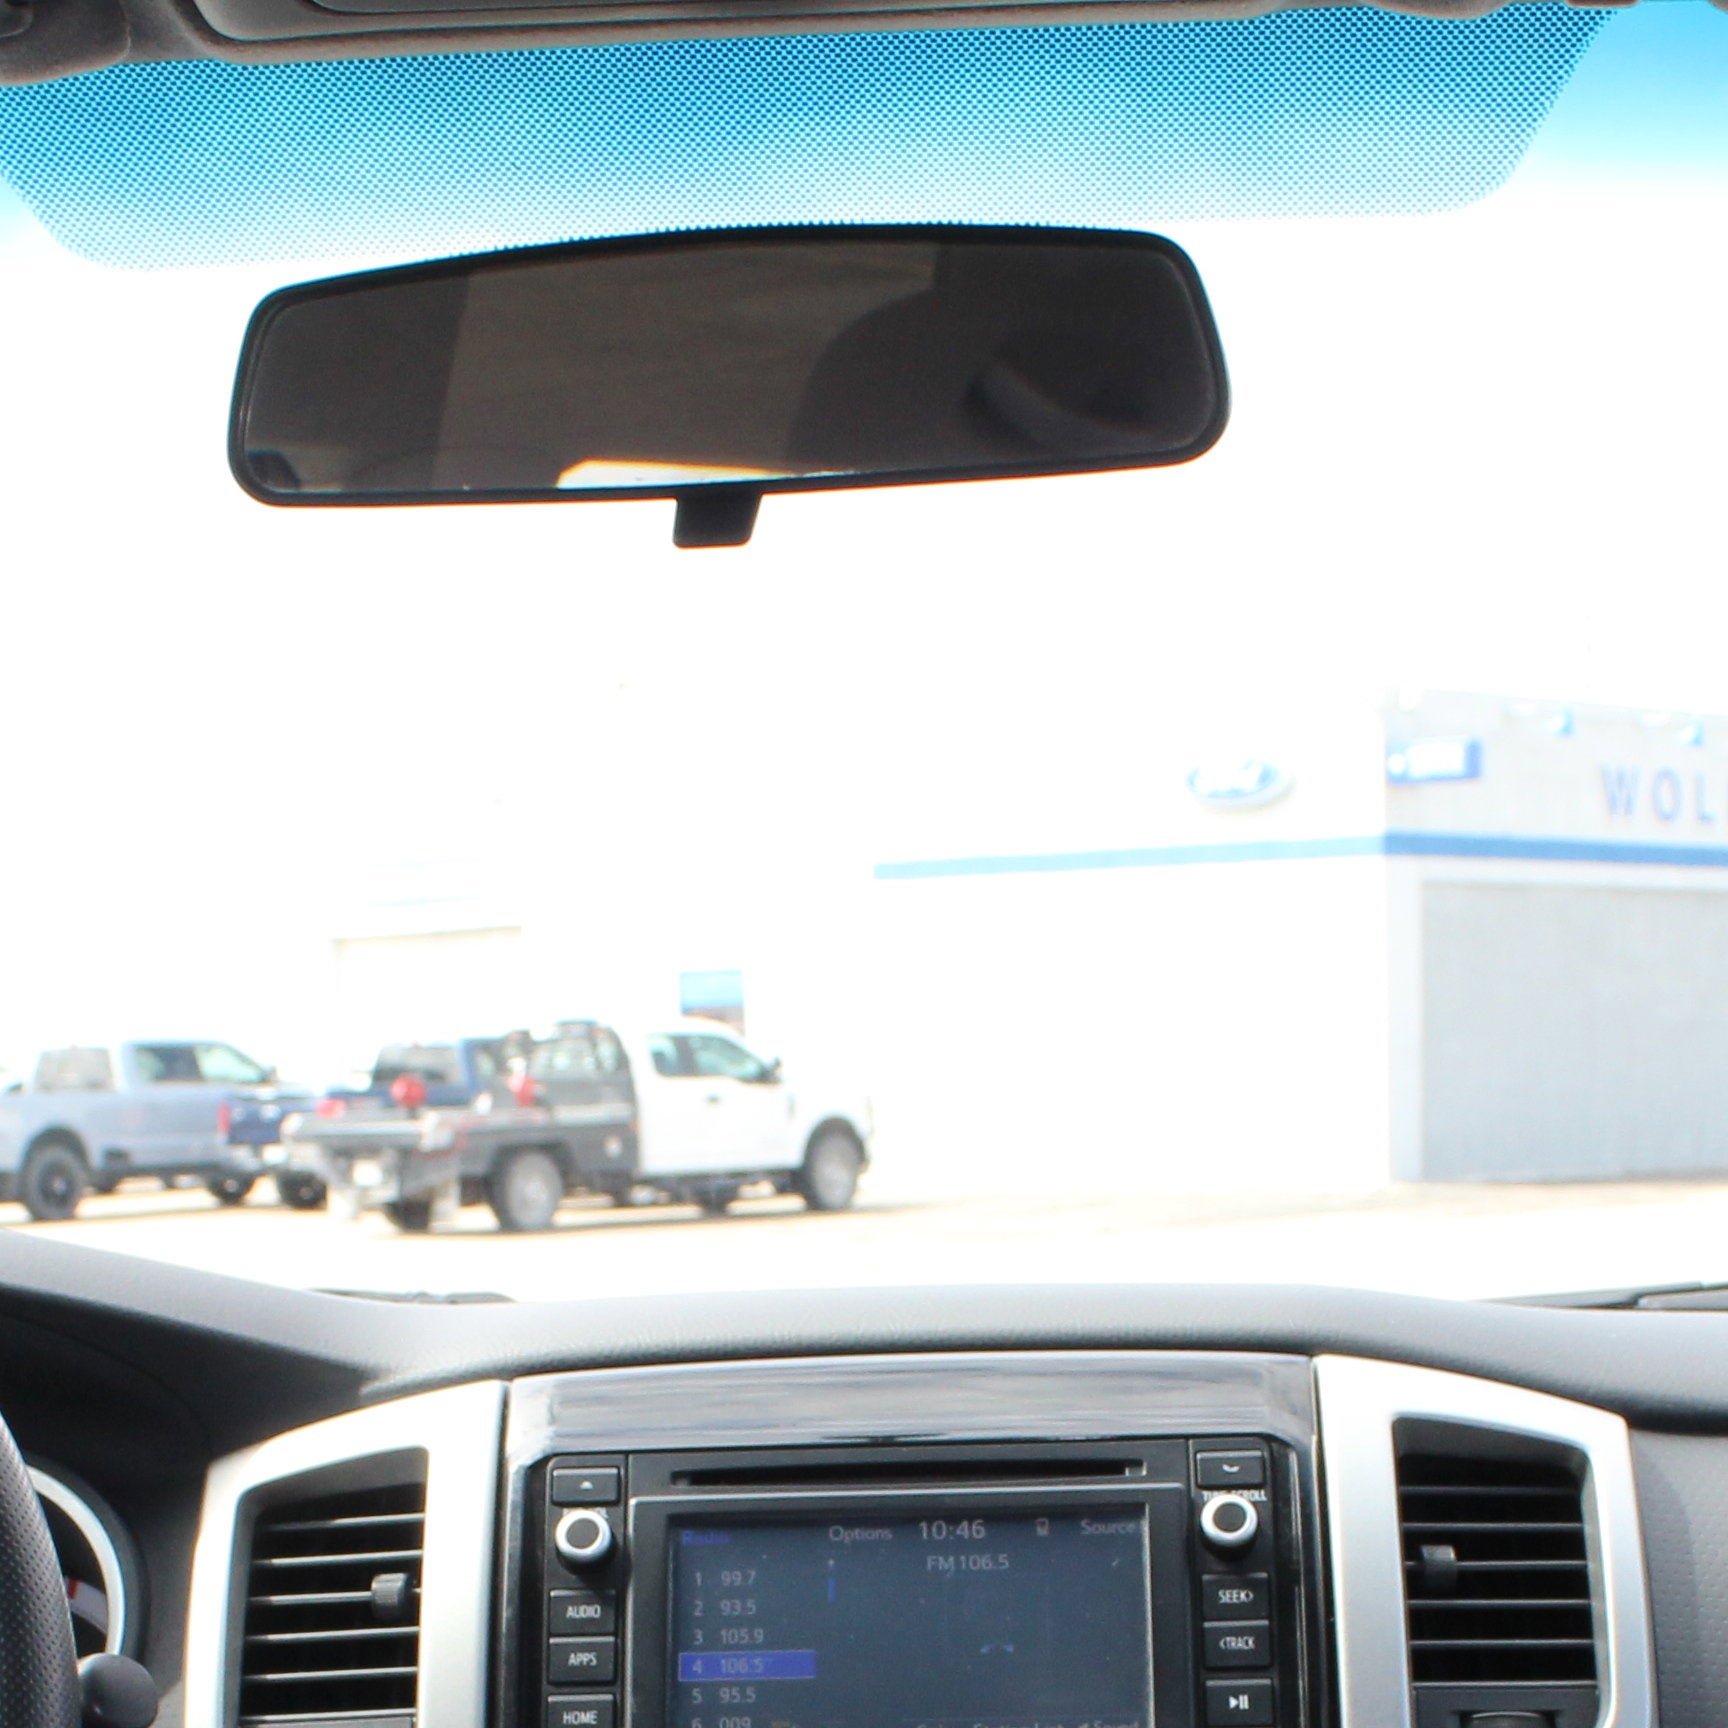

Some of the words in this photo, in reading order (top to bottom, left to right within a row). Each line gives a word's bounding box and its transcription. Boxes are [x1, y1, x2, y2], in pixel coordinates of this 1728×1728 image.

[829, 1525, 893, 1544] Options
[919, 1519, 986, 1540] 10:46
[1080, 1519, 1138, 1535] Source
[926, 1556, 954, 1571] FM
[960, 1554, 1010, 1571] 106.5
[721, 1570, 756, 1586] 99.7
[566, 1604, 601, 1618] AUDIO
[721, 1629, 764, 1644] 105.9
[568, 1652, 598, 1666] APPS
[721, 1658, 764, 1674] 106.5
[719, 1687, 757, 1703] 95.5
[563, 1711, 598, 1725] HOME
